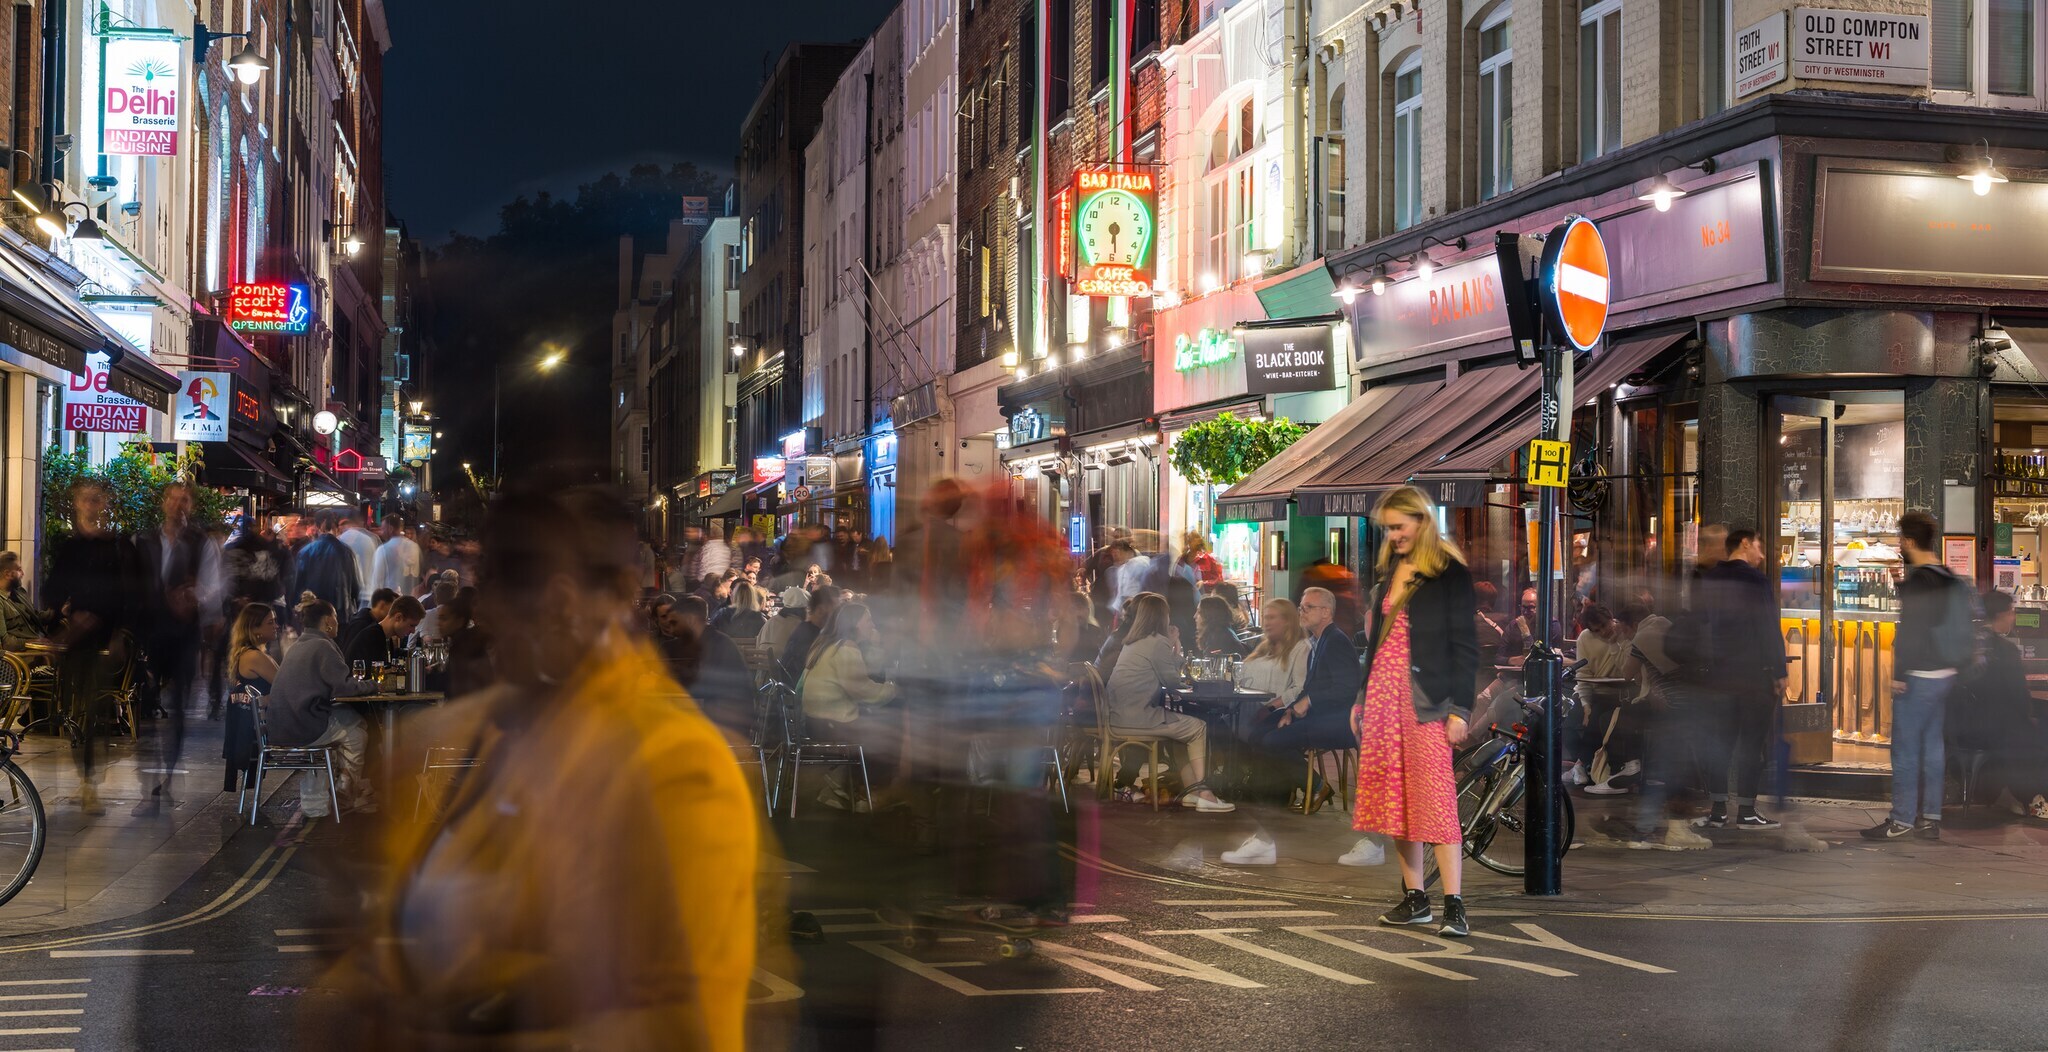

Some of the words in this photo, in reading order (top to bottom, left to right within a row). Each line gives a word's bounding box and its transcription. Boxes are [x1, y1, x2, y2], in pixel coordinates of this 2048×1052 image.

[1805, 15, 1835, 34] OLD
[1843, 17, 1919, 40] COMPTON
[1739, 28, 1760, 53] FRITH
[1805, 37, 1863, 58] STREET
[1869, 41, 1890, 60] W1
[1739, 47, 1766, 74] STREET
[1768, 41, 1780, 61] W1
[1805, 65, 1821, 75] CITY
[1823, 66, 1832, 75] OF
[1834, 67, 1885, 78] WESTMINSTER
[1739, 82, 1747, 93] CITY
[1748, 80, 1752, 89] OF
[1753, 70, 1777, 87] WESTMINSTER
[132, 85, 144, 93] The
[107, 87, 175, 116] Delhi
[132, 116, 175, 126] Brasserie
[111, 130, 171, 143] INDIAN
[111, 141, 171, 154] CUISINE
[1081, 173, 1108, 188] BAR
[1111, 174, 1152, 190] ITALIA
[1098, 201, 1104, 209] 11
[1110, 197, 1120, 205] 12
[1127, 202, 1131, 210] 1
[1089, 211, 1098, 219] 10
[1133, 213, 1139, 221] 2
[1137, 227, 1143, 235] 3
[1702, 224, 1715, 248] No
[1717, 220, 1730, 244] 34
[1089, 238, 1095, 246] 8
[1094, 252, 1100, 261] 7
[1109, 253, 1115, 261] 6
[1126, 254, 1131, 263] 5
[1095, 266, 1134, 280] CAFFE
[234, 285, 287, 297] ronnie
[1079, 279, 1149, 295] ESPRESSO
[234, 296, 285, 307] scott's
[1429, 273, 1495, 326] BALANS
[1283, 343, 1295, 351] THE
[1256, 352, 1292, 369] BLACK
[1294, 351, 1325, 366] BOOK
[73, 404, 140, 420] INDIAN
[1549, 400, 1558, 415] S
[72, 417, 139, 431] CUISINE
[180, 422, 223, 432] ZIMA
[1549, 417, 1557, 430] 7
[1534, 445, 1565, 482] H
[1441, 482, 1456, 502] CAFE
[1333, 494, 1342, 513] DAY
[1351, 494, 1367, 513] NIGHT
